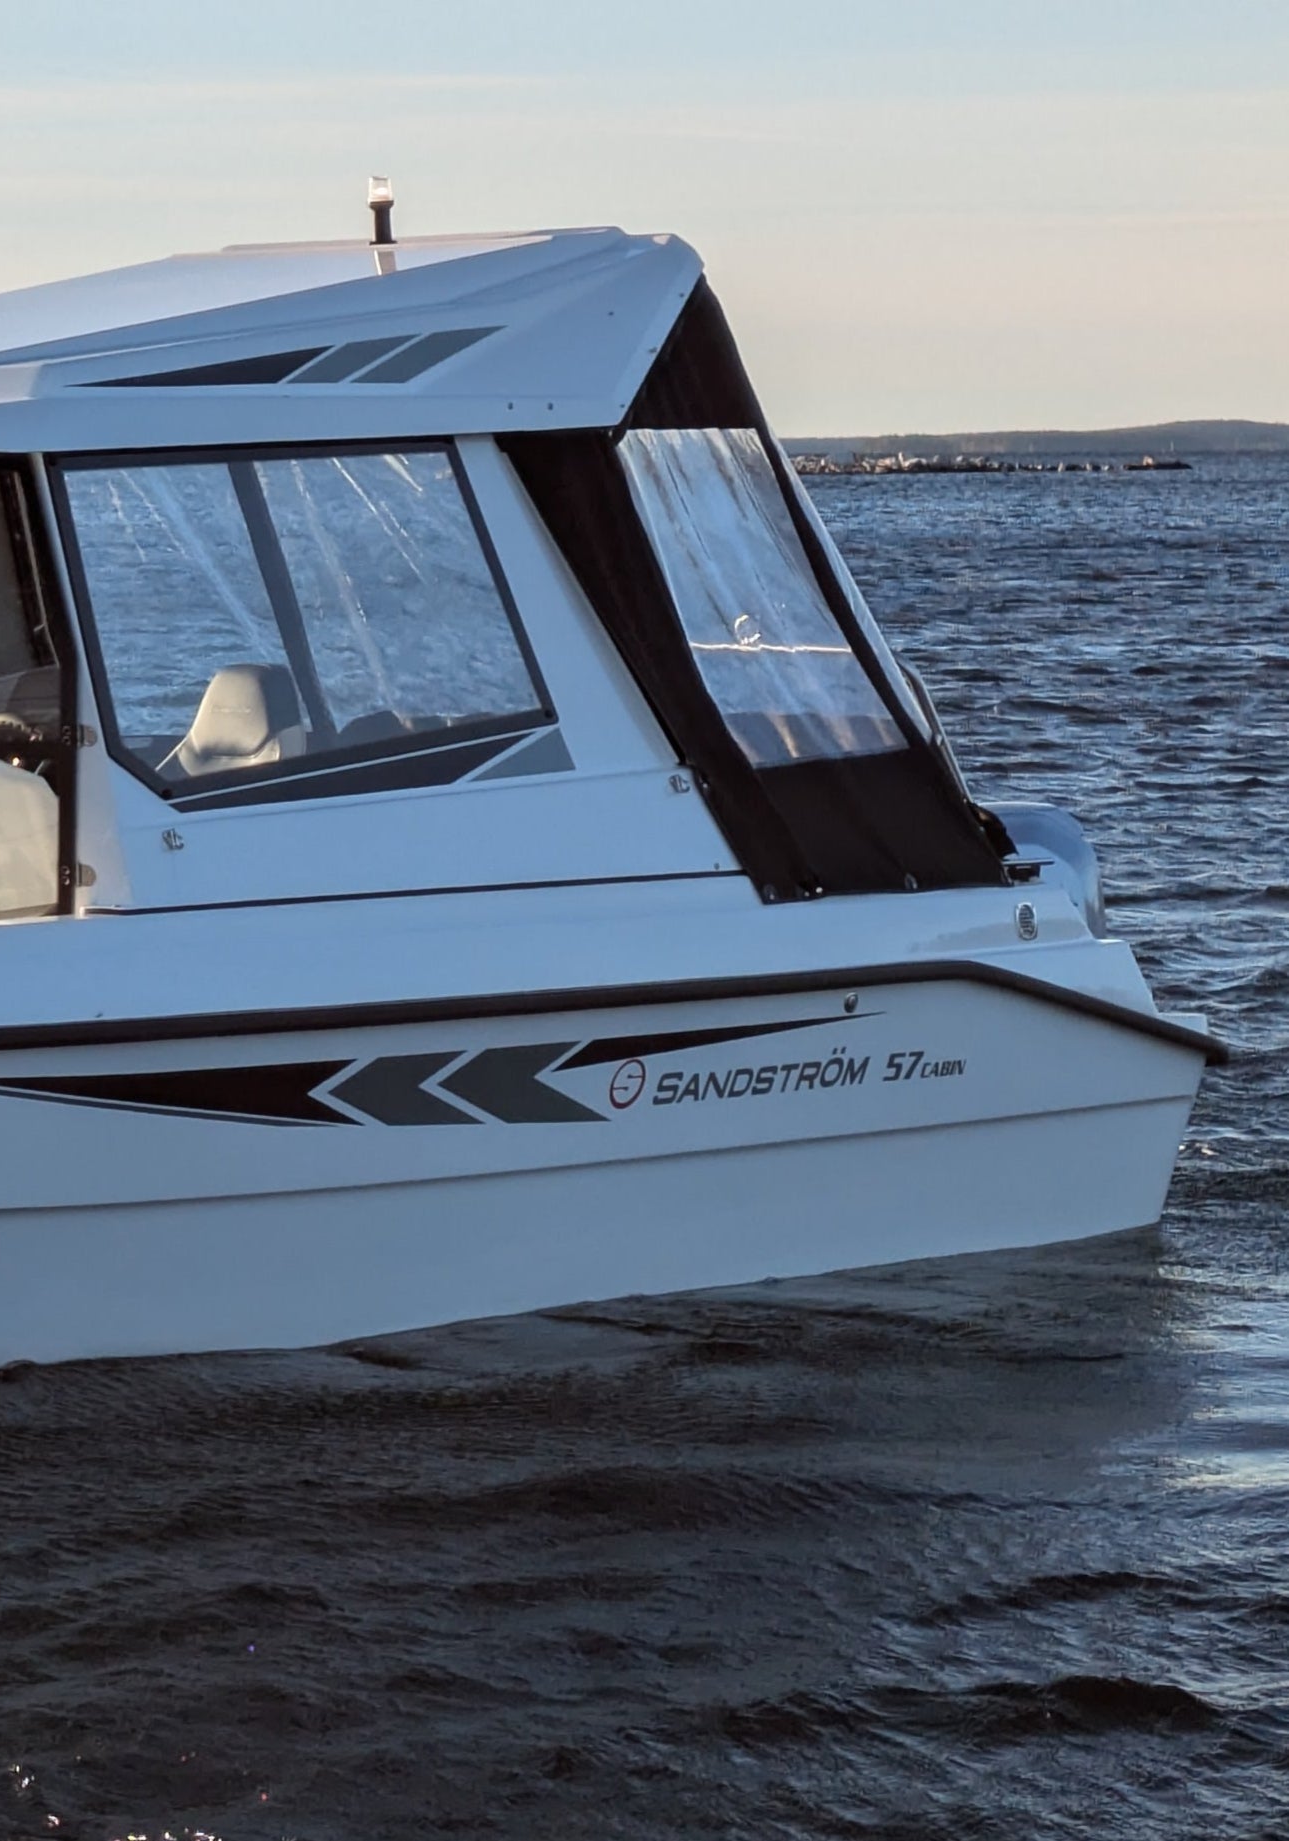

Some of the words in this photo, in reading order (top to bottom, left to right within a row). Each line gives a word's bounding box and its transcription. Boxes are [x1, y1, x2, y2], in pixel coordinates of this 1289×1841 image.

[652, 1047, 870, 1105] SANDSTRÖM
[882, 1051, 924, 1081] 57
[920, 1059, 967, 1078] CABIN
